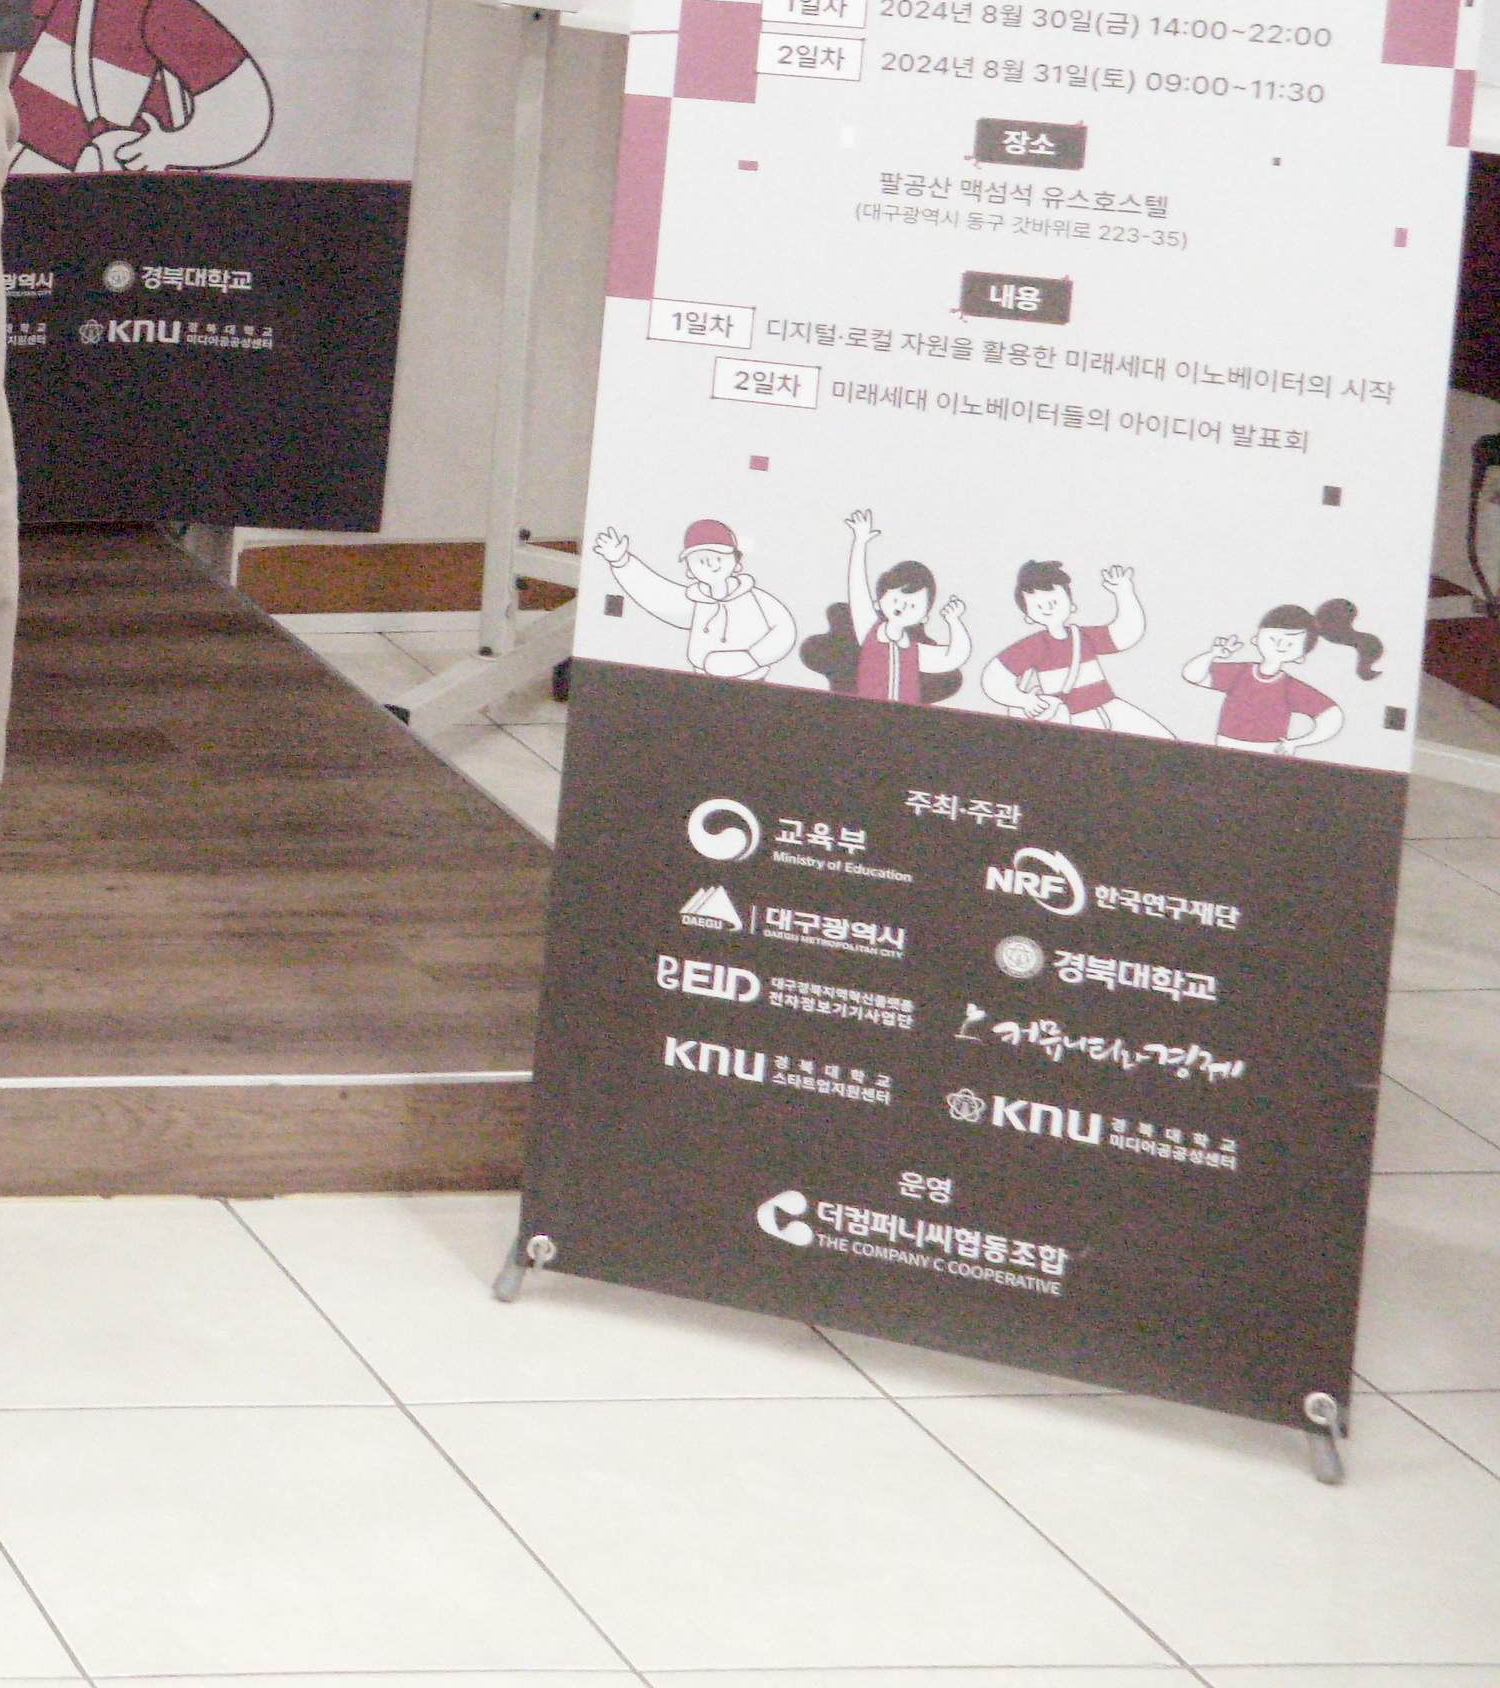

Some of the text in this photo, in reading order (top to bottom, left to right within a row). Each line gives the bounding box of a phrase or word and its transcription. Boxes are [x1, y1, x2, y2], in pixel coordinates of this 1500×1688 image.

[982, 2, 1023, 29] 8월
[1032, 8, 1140, 40] 30일(금)
[1148, 15, 1333, 49] 14:00~22:00
[777, 42, 1324, 105] 2일차 2024년 8월 31일(토) 09:00~11:30
[1003, 130, 1056, 158] 장소
[879, 171, 1170, 218] 팔공산 맥섬석 유스호스텔
[855, 201, 1188, 250] (대구광역시 동구 갓바위로 223-35)
[142, 266, 252, 293] 경북대학교
[989, 284, 1042, 312] 내용
[670, 310, 732, 338] 1일차
[901, 331, 974, 362] 자원을
[982, 338, 1057, 370] 활용한
[1066, 345, 1167, 382] 미래세대
[1175, 356, 1333, 400] 이노베이터의
[1342, 375, 1396, 405] 시작
[734, 369, 1309, 454] 2일차 미래세대 이노베이터들의 아이디어 발표회
[775, 818, 866, 854] 교육부
[773, 851, 913, 883] Ministry of Education
[985, 866, 1066, 900] NRF
[682, 915, 722, 930] DAEGU
[765, 907, 906, 951] 대구광역시
[1095, 885, 1241, 929] 한국연구재단
[1054, 949, 1217, 1001] 경북대학교
[769, 991, 914, 1029] 전자정보기기사업단
[772, 1071, 891, 1105] 스타트업지원센터
[898, 1171, 951, 1204] 운영
[817, 1201, 1068, 1276] 더컴퍼니씨협동조합
[816, 1232, 1061, 1296] THE COMPANY C COOPERATIVE
